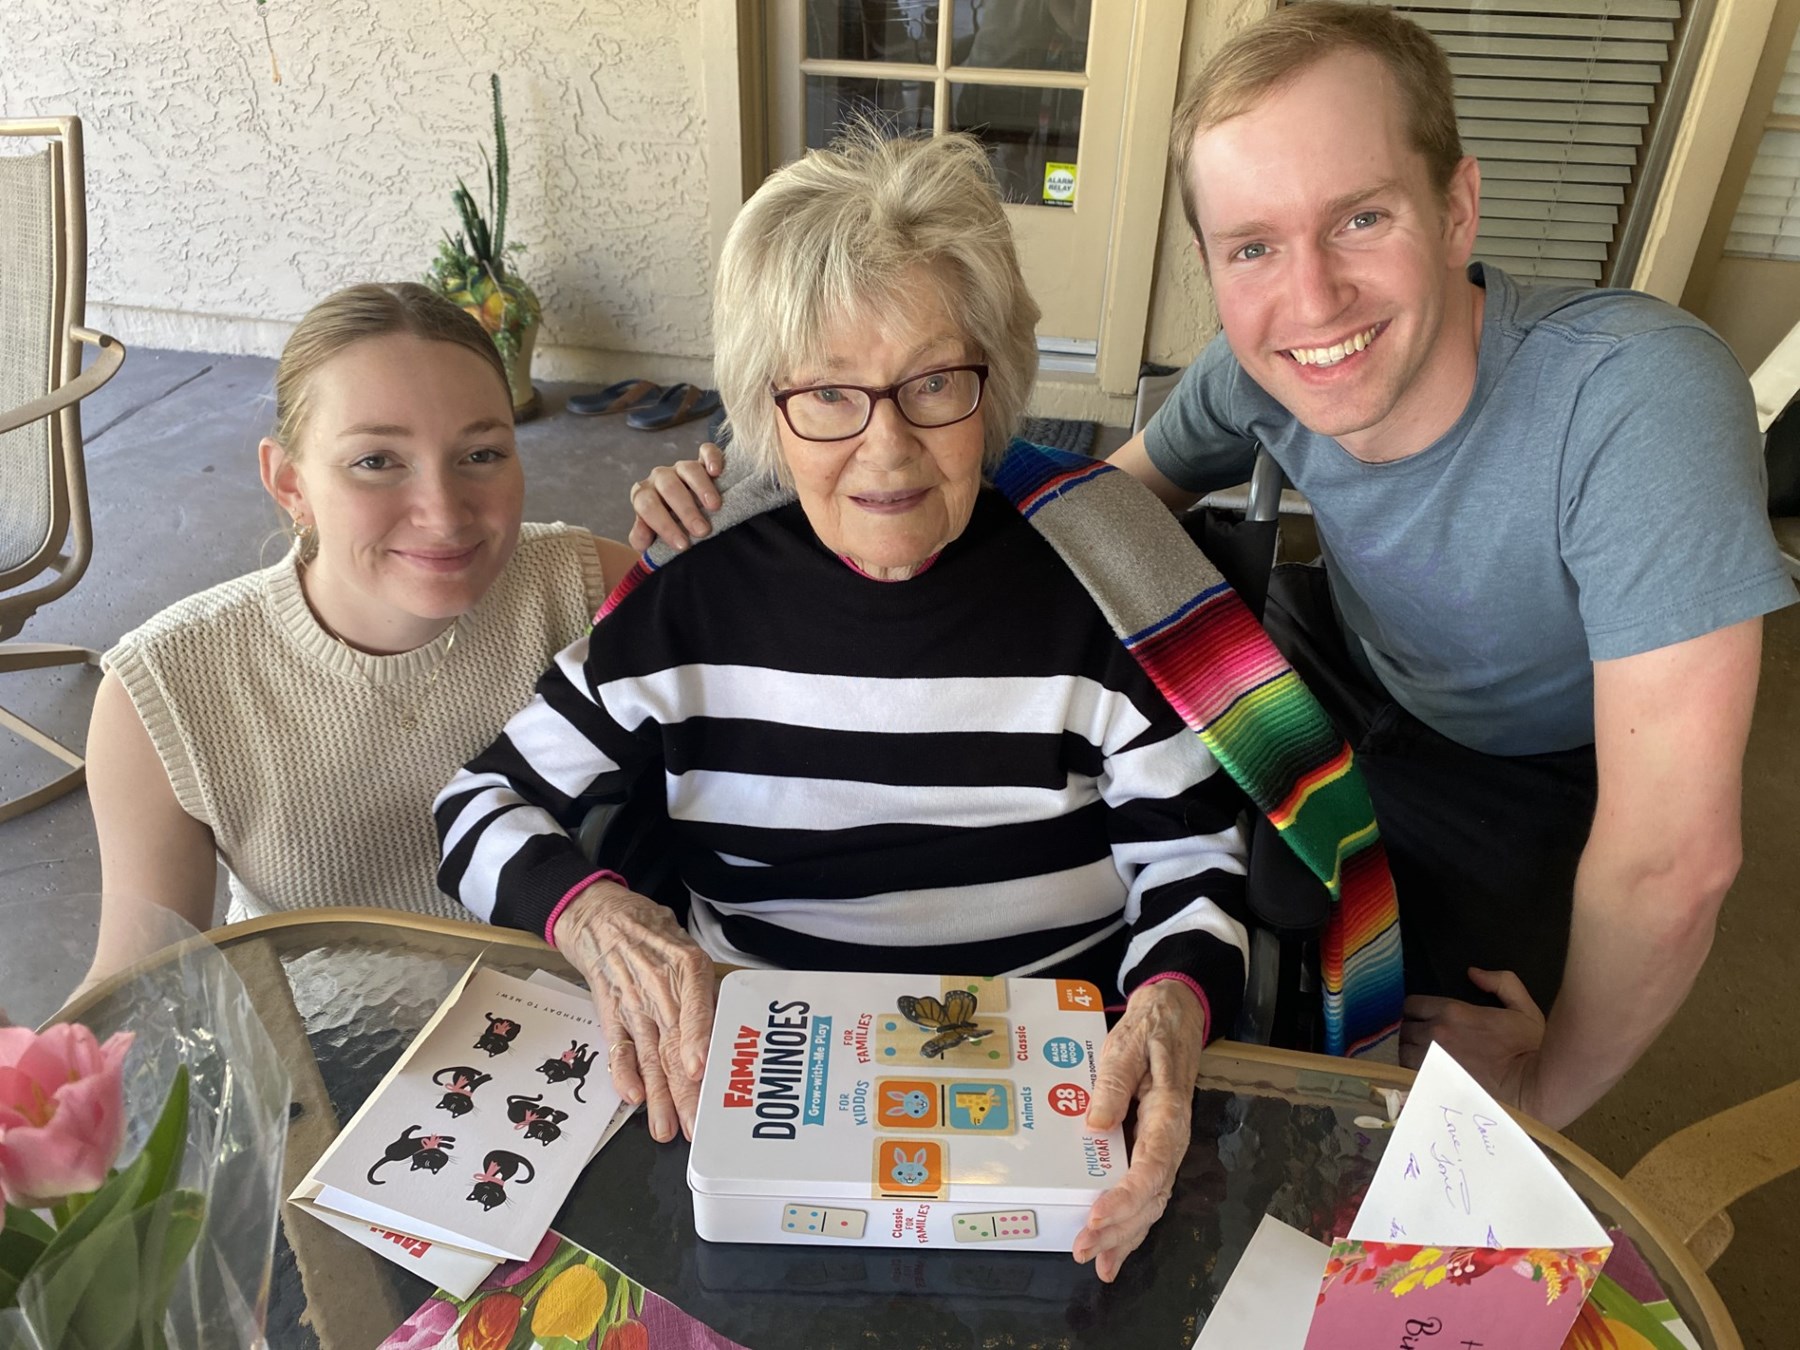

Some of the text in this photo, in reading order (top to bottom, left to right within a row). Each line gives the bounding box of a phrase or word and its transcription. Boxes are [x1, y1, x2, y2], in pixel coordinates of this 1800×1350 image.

[496, 991, 593, 1025] BIRTHDAY TO MEW!
[1074, 986, 1093, 1007] 4+
[843, 1029, 854, 1046] FOR
[855, 1013, 873, 1064] FAMILIES
[1015, 1025, 1028, 1061] Classic
[1085, 1040, 1093, 1050] SET
[1051, 1042, 1060, 1062] MADE
[1059, 1042, 1068, 1062] FROM
[1068, 1041, 1077, 1064] WOOD
[1087, 1051, 1096, 1073] DOMINO
[724, 1025, 761, 1108] FAMILY
[752, 1000, 810, 1140] DOMINOES
[808, 1023, 830, 1117] Grow-with-Me Play
[838, 1093, 850, 1111] FOR
[852, 1080, 870, 1126] KIDDOS
[1020, 1086, 1034, 1130] Animals
[1056, 1088, 1078, 1111] 28
[1077, 1090, 1086, 1109] TILES
[1082, 1136, 1106, 1177] CHUCKLE
[1094, 1139, 1111, 1162] ROAR
[892, 1208, 903, 1238] Classic
[905, 1217, 913, 1230] FOR
[915, 1204, 930, 1243] FAMILIES
[370, 1226, 432, 1258] FAM
